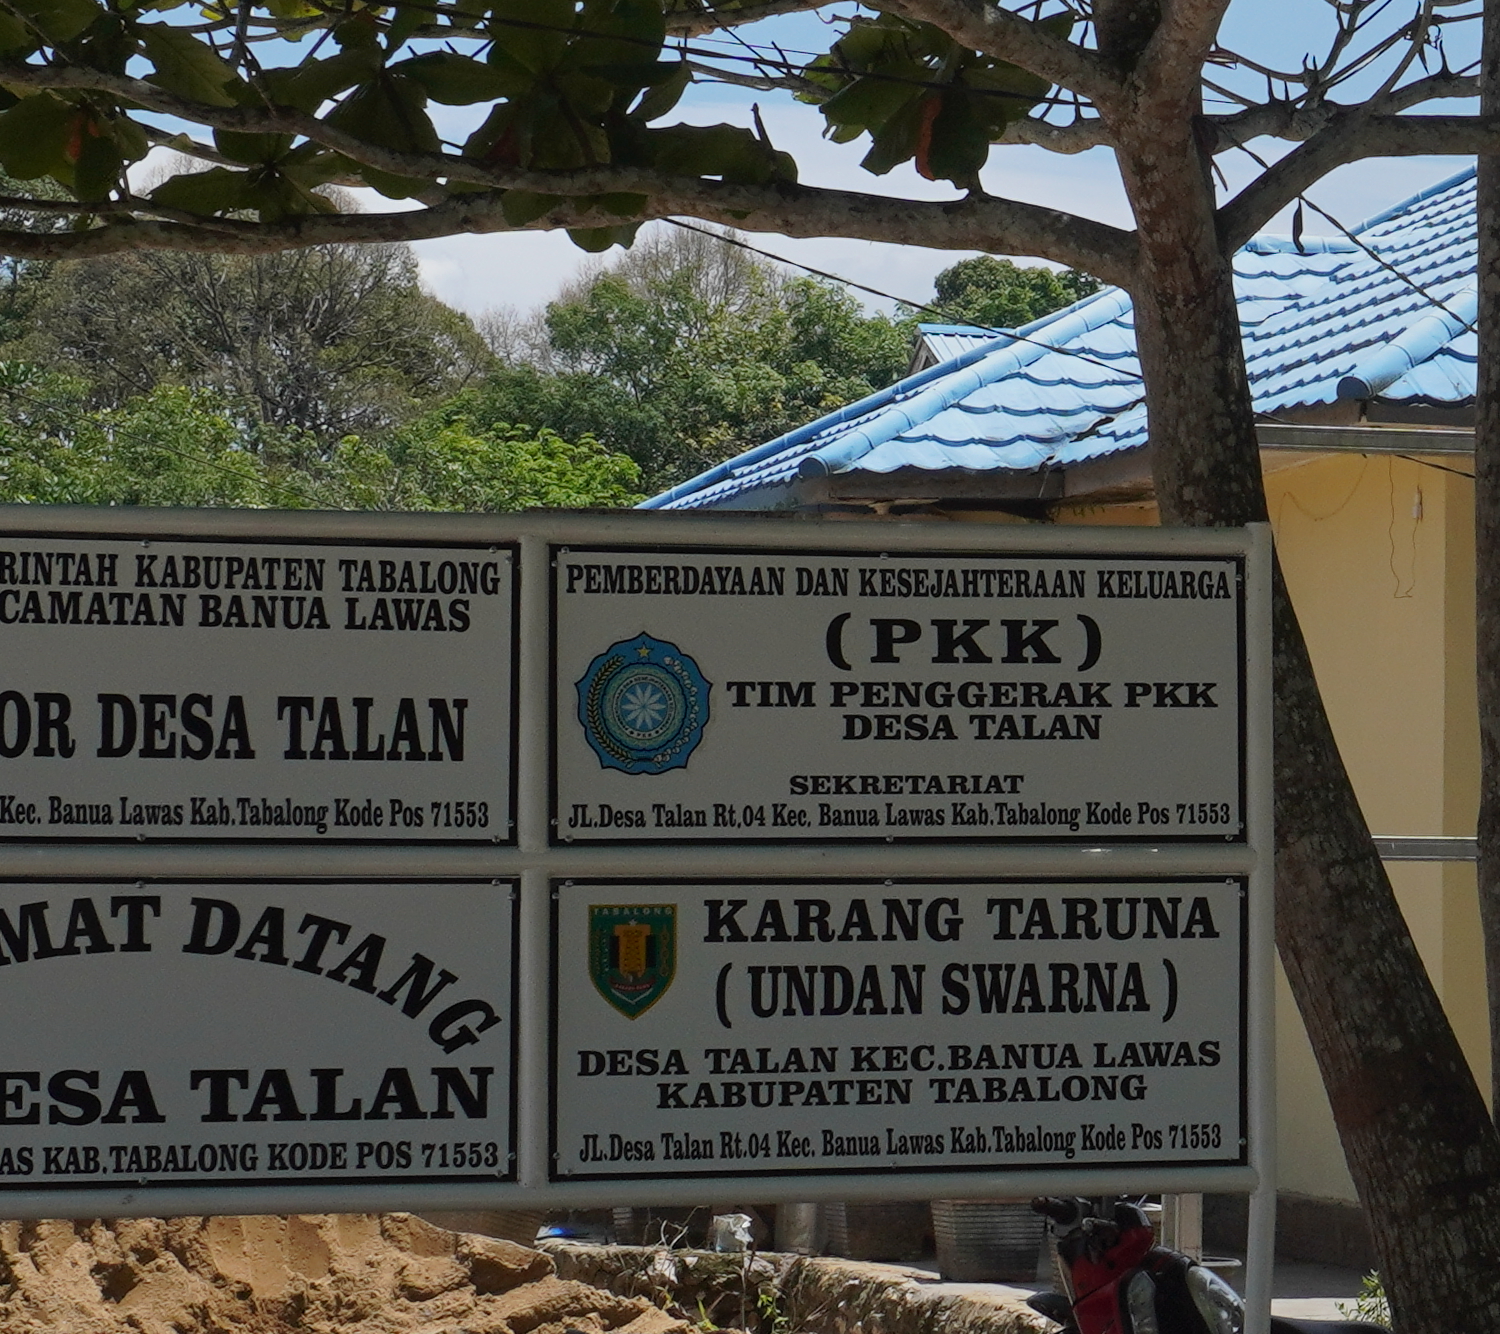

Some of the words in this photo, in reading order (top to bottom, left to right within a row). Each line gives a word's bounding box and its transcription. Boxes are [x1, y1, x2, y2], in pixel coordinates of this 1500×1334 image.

[134, 554, 326, 592] KABUPATEN
[338, 559, 501, 596] TABALONG
[565, 564, 786, 596] PEMBERDAYAAN
[795, 567, 850, 597] DAN
[858, 567, 1086, 599] KESEJAHTERAAN
[1096, 570, 1232, 600] KELUARGA
[198, 594, 331, 630] BANUA
[344, 597, 471, 633] LAWAS
[726, 681, 817, 708] TIM
[829, 681, 1113, 709] PENGGERAK
[1123, 682, 1219, 708] PKK
[96, 692, 256, 761] DESA
[277, 695, 469, 762] TALAN
[842, 713, 959, 741] DESA
[969, 714, 1103, 740] TALAN
[789, 774, 1025, 796] SEKRETARIAT
[48, 795, 114, 826] Banua
[119, 796, 184, 826] Lawas
[333, 798, 384, 827] Kode
[389, 798, 424, 828] Pos
[430, 801, 489, 828] 71553
[703, 897, 964, 943] KARANG
[986, 896, 1220, 941] TARUNA
[182, 897, 500, 1054] DATANG
[577, 1048, 690, 1077] DESA
[704, 1046, 839, 1075] TALAN
[1093, 1040, 1221, 1068] LAWAS
[190, 1066, 495, 1123] TALAN
[656, 1078, 913, 1109] KABUPATEN
[929, 1074, 1148, 1104] TABALONG
[267, 1142, 348, 1171] KODE
[355, 1140, 412, 1170] POS
[421, 1141, 499, 1168] 71553
